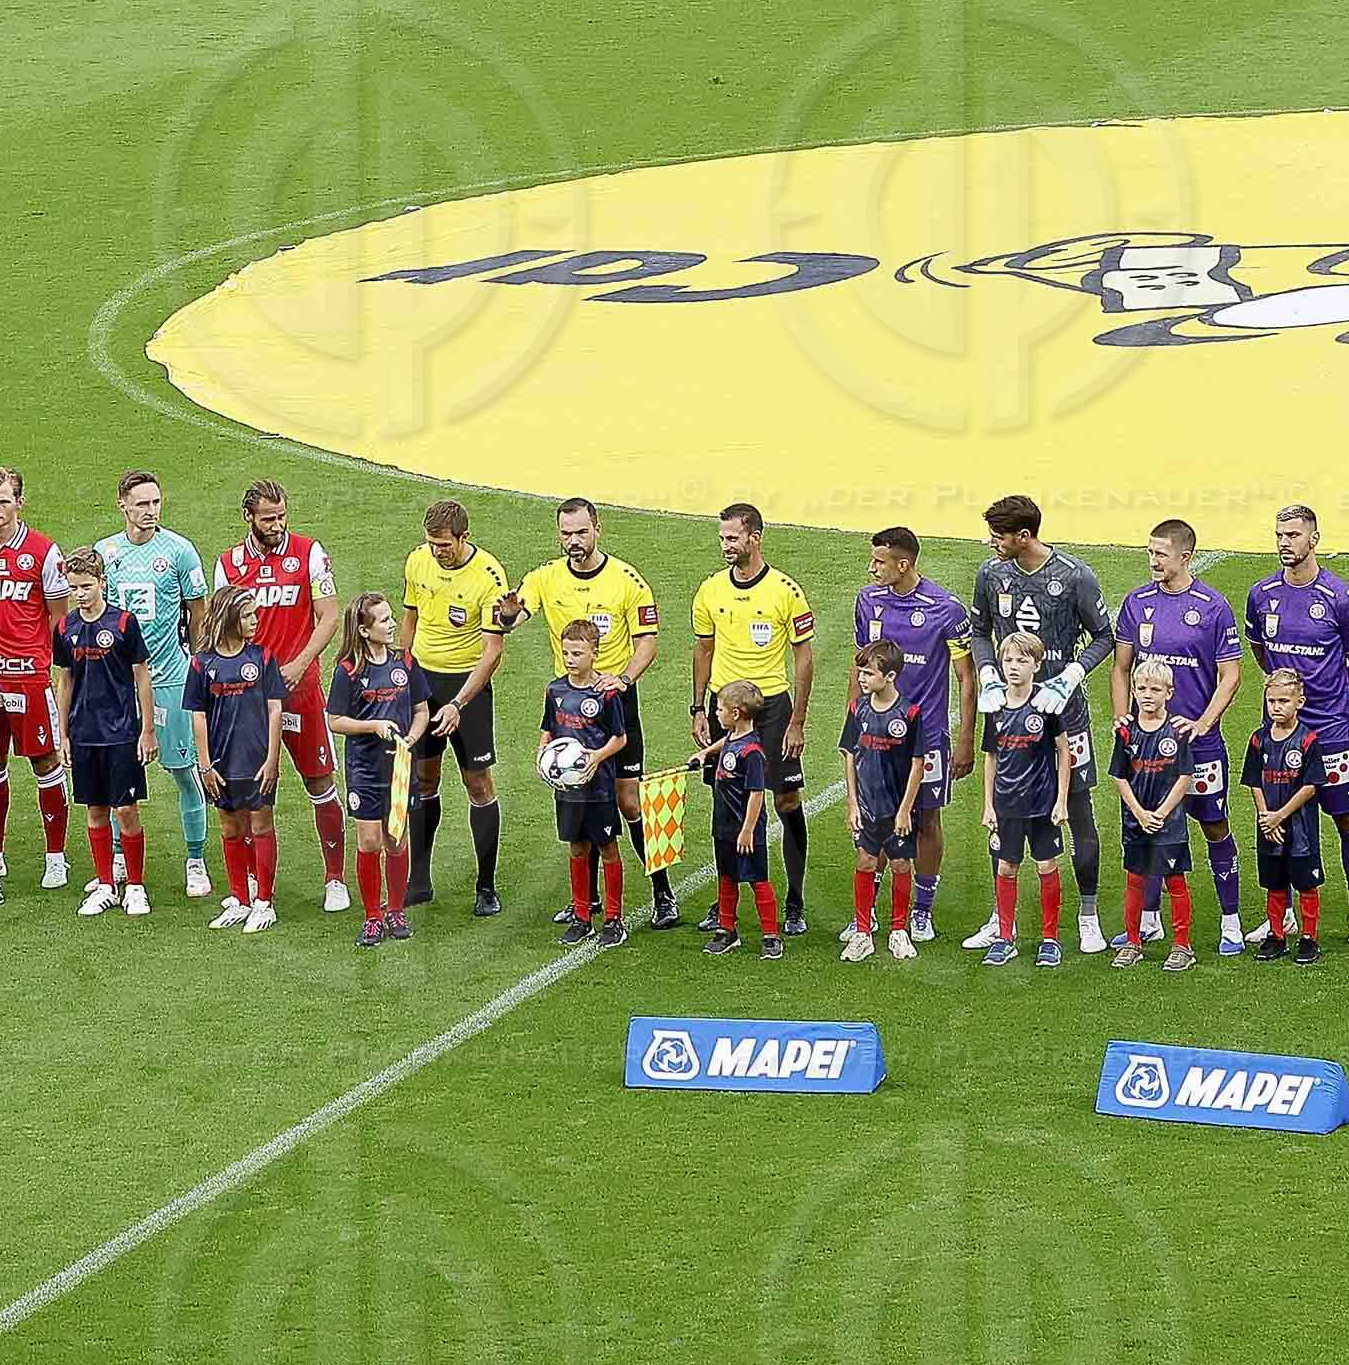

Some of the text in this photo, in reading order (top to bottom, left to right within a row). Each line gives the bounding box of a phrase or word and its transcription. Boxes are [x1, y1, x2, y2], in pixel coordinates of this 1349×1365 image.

[356, 250, 881, 304] Car
[249, 585, 301, 607] APEI
[751, 623, 771, 633] FIFA
[708, 1038, 850, 1079] MAPEI
[1175, 1067, 1314, 1116] MAPEI
